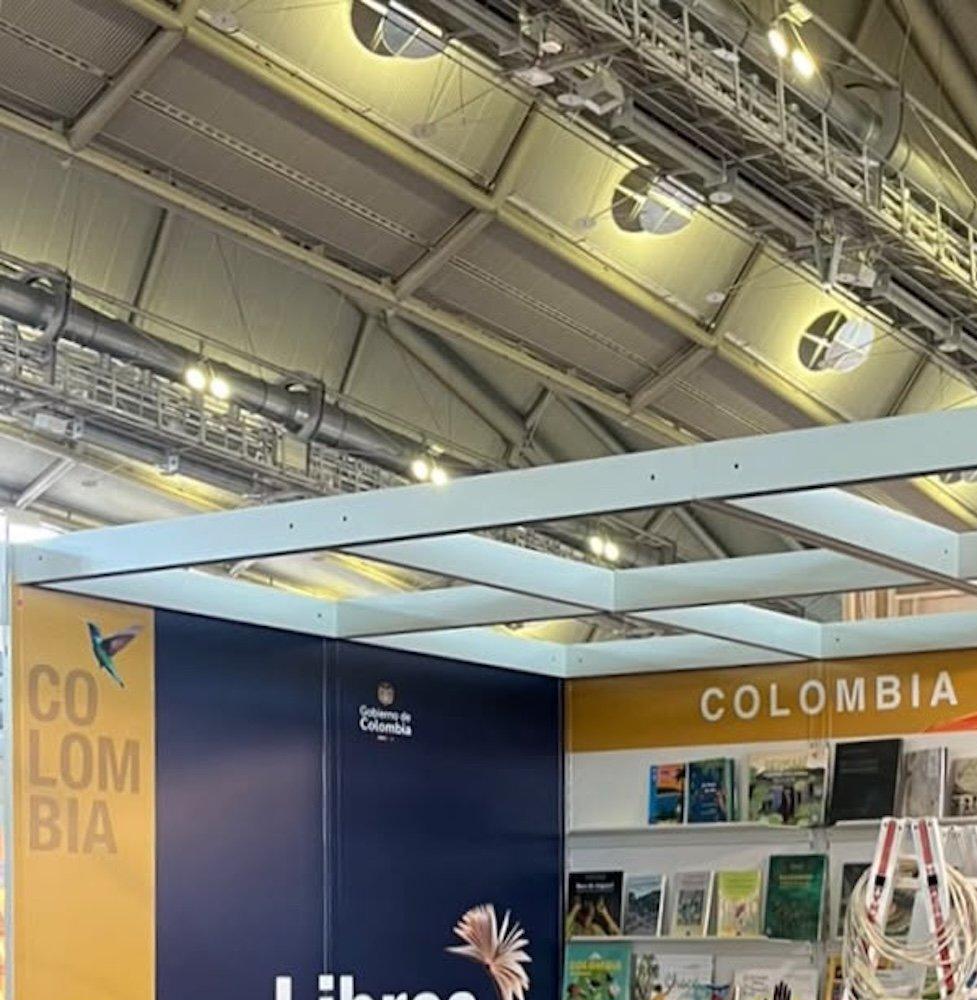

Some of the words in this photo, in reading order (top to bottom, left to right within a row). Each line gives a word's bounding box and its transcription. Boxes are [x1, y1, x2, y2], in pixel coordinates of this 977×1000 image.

[27, 663, 99, 727] CO
[701, 670, 959, 722] COLOMBIA
[360, 717, 412, 735] Colombia
[28, 732, 141, 795] LOM
[28, 796, 118, 855] BIA
